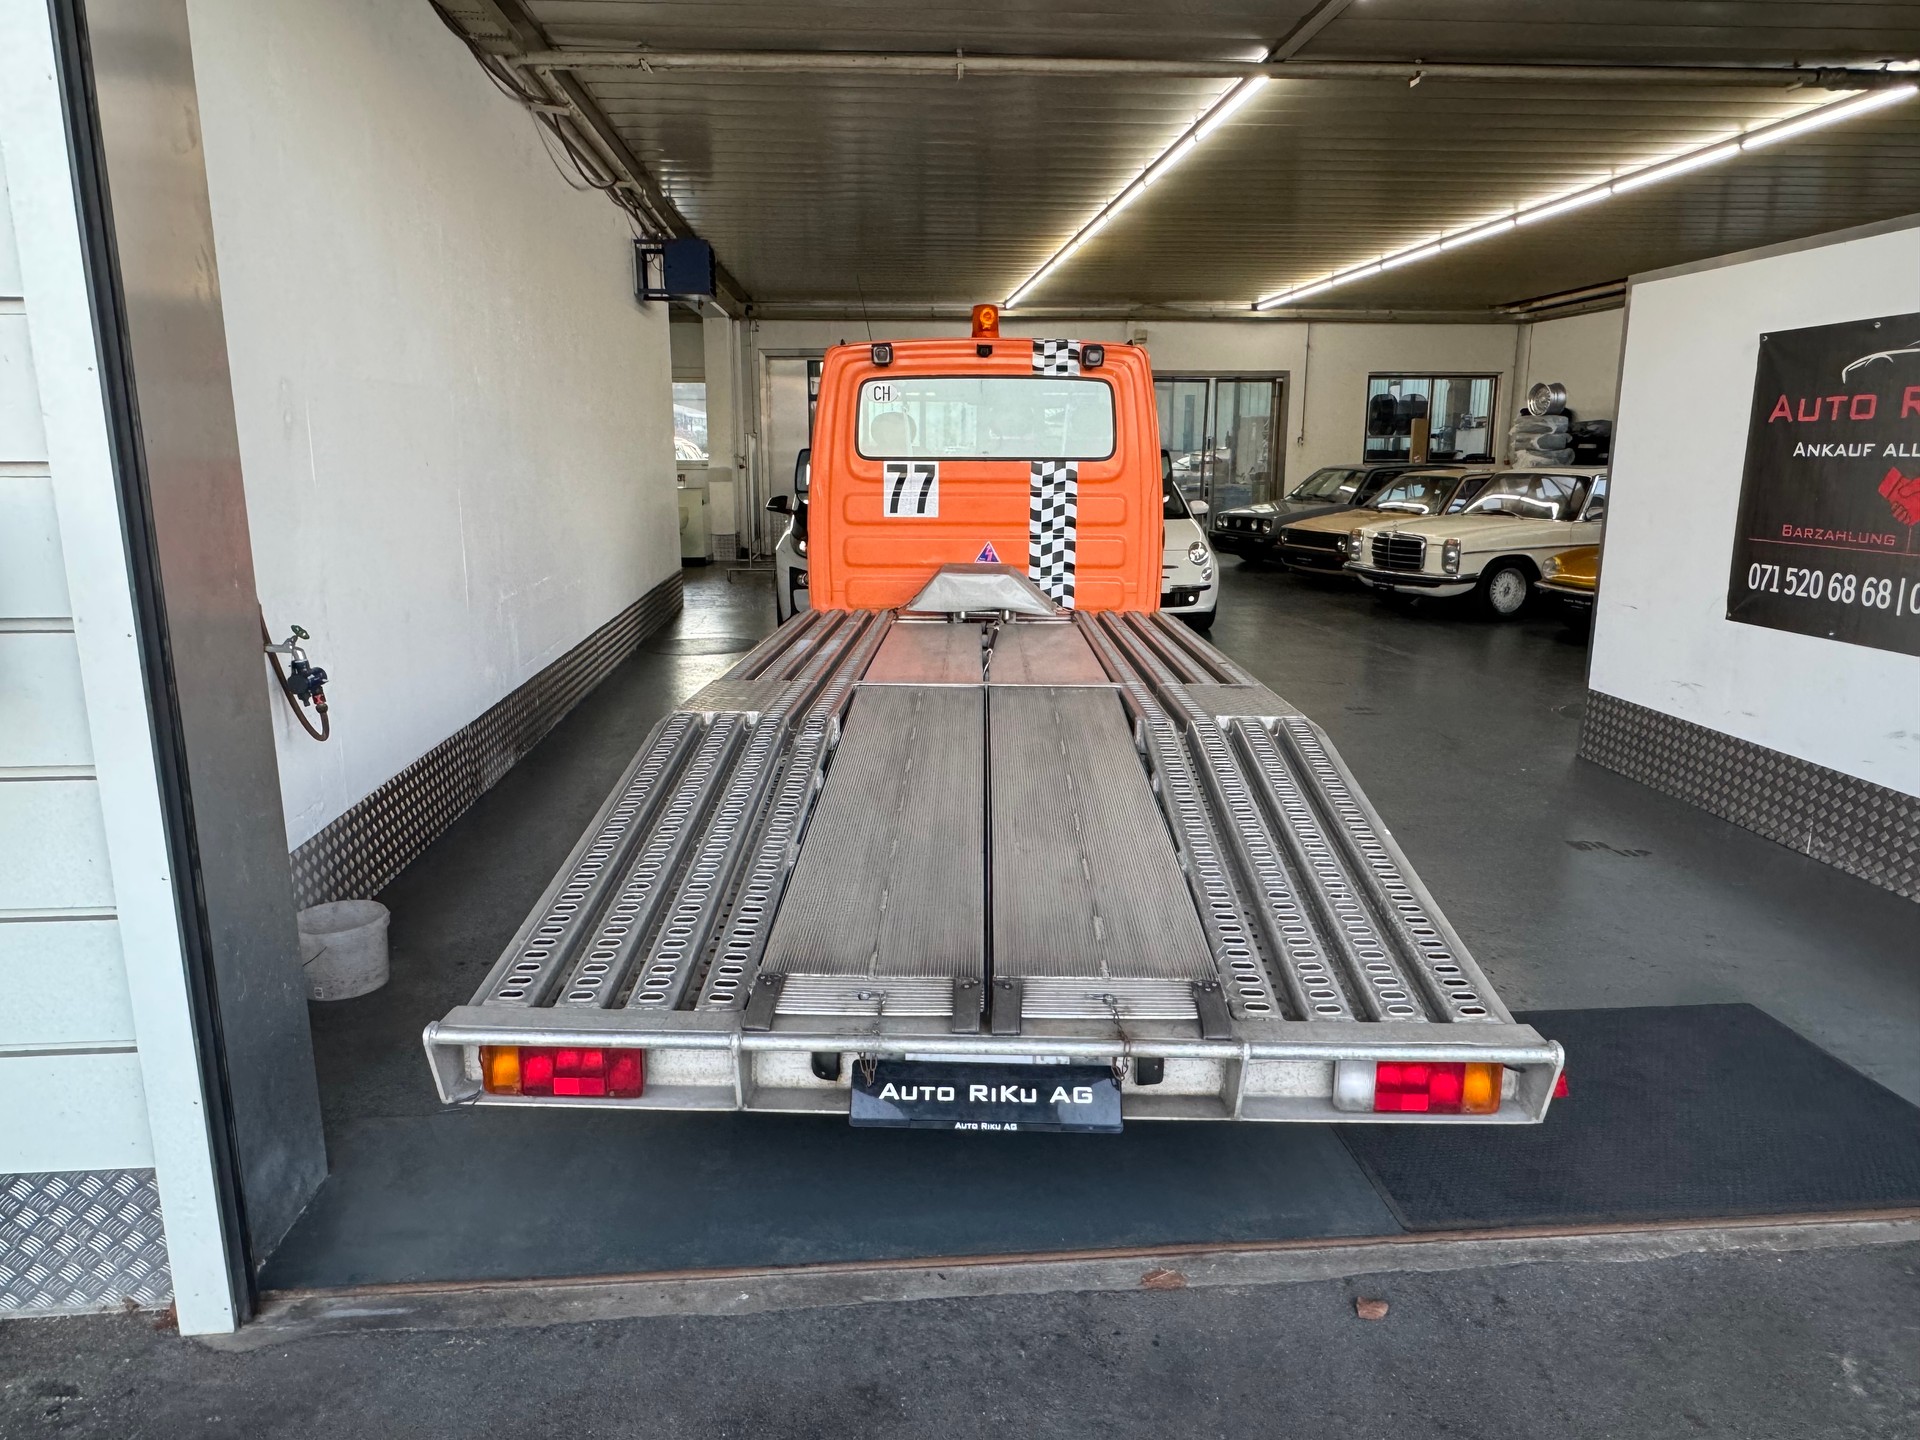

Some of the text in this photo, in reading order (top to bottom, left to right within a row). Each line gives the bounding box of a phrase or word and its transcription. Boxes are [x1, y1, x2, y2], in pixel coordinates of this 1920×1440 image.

[873, 385, 891, 402] CH
[1768, 394, 1878, 423] AUTO
[1793, 441, 1876, 457] ANKAUF
[886, 464, 936, 514] 77
[1782, 524, 1896, 546] BARZAHLUNG
[1748, 562, 1780, 593] 071
[1783, 567, 1824, 599] 520
[1827, 572, 1857, 604] 68
[1861, 576, 1893, 609] 68
[878, 1082, 955, 1102] AUTO
[1049, 1086, 1093, 1104] AG
[954, 1121, 978, 1130] AUTO
[1003, 1122, 1018, 1131] AG
